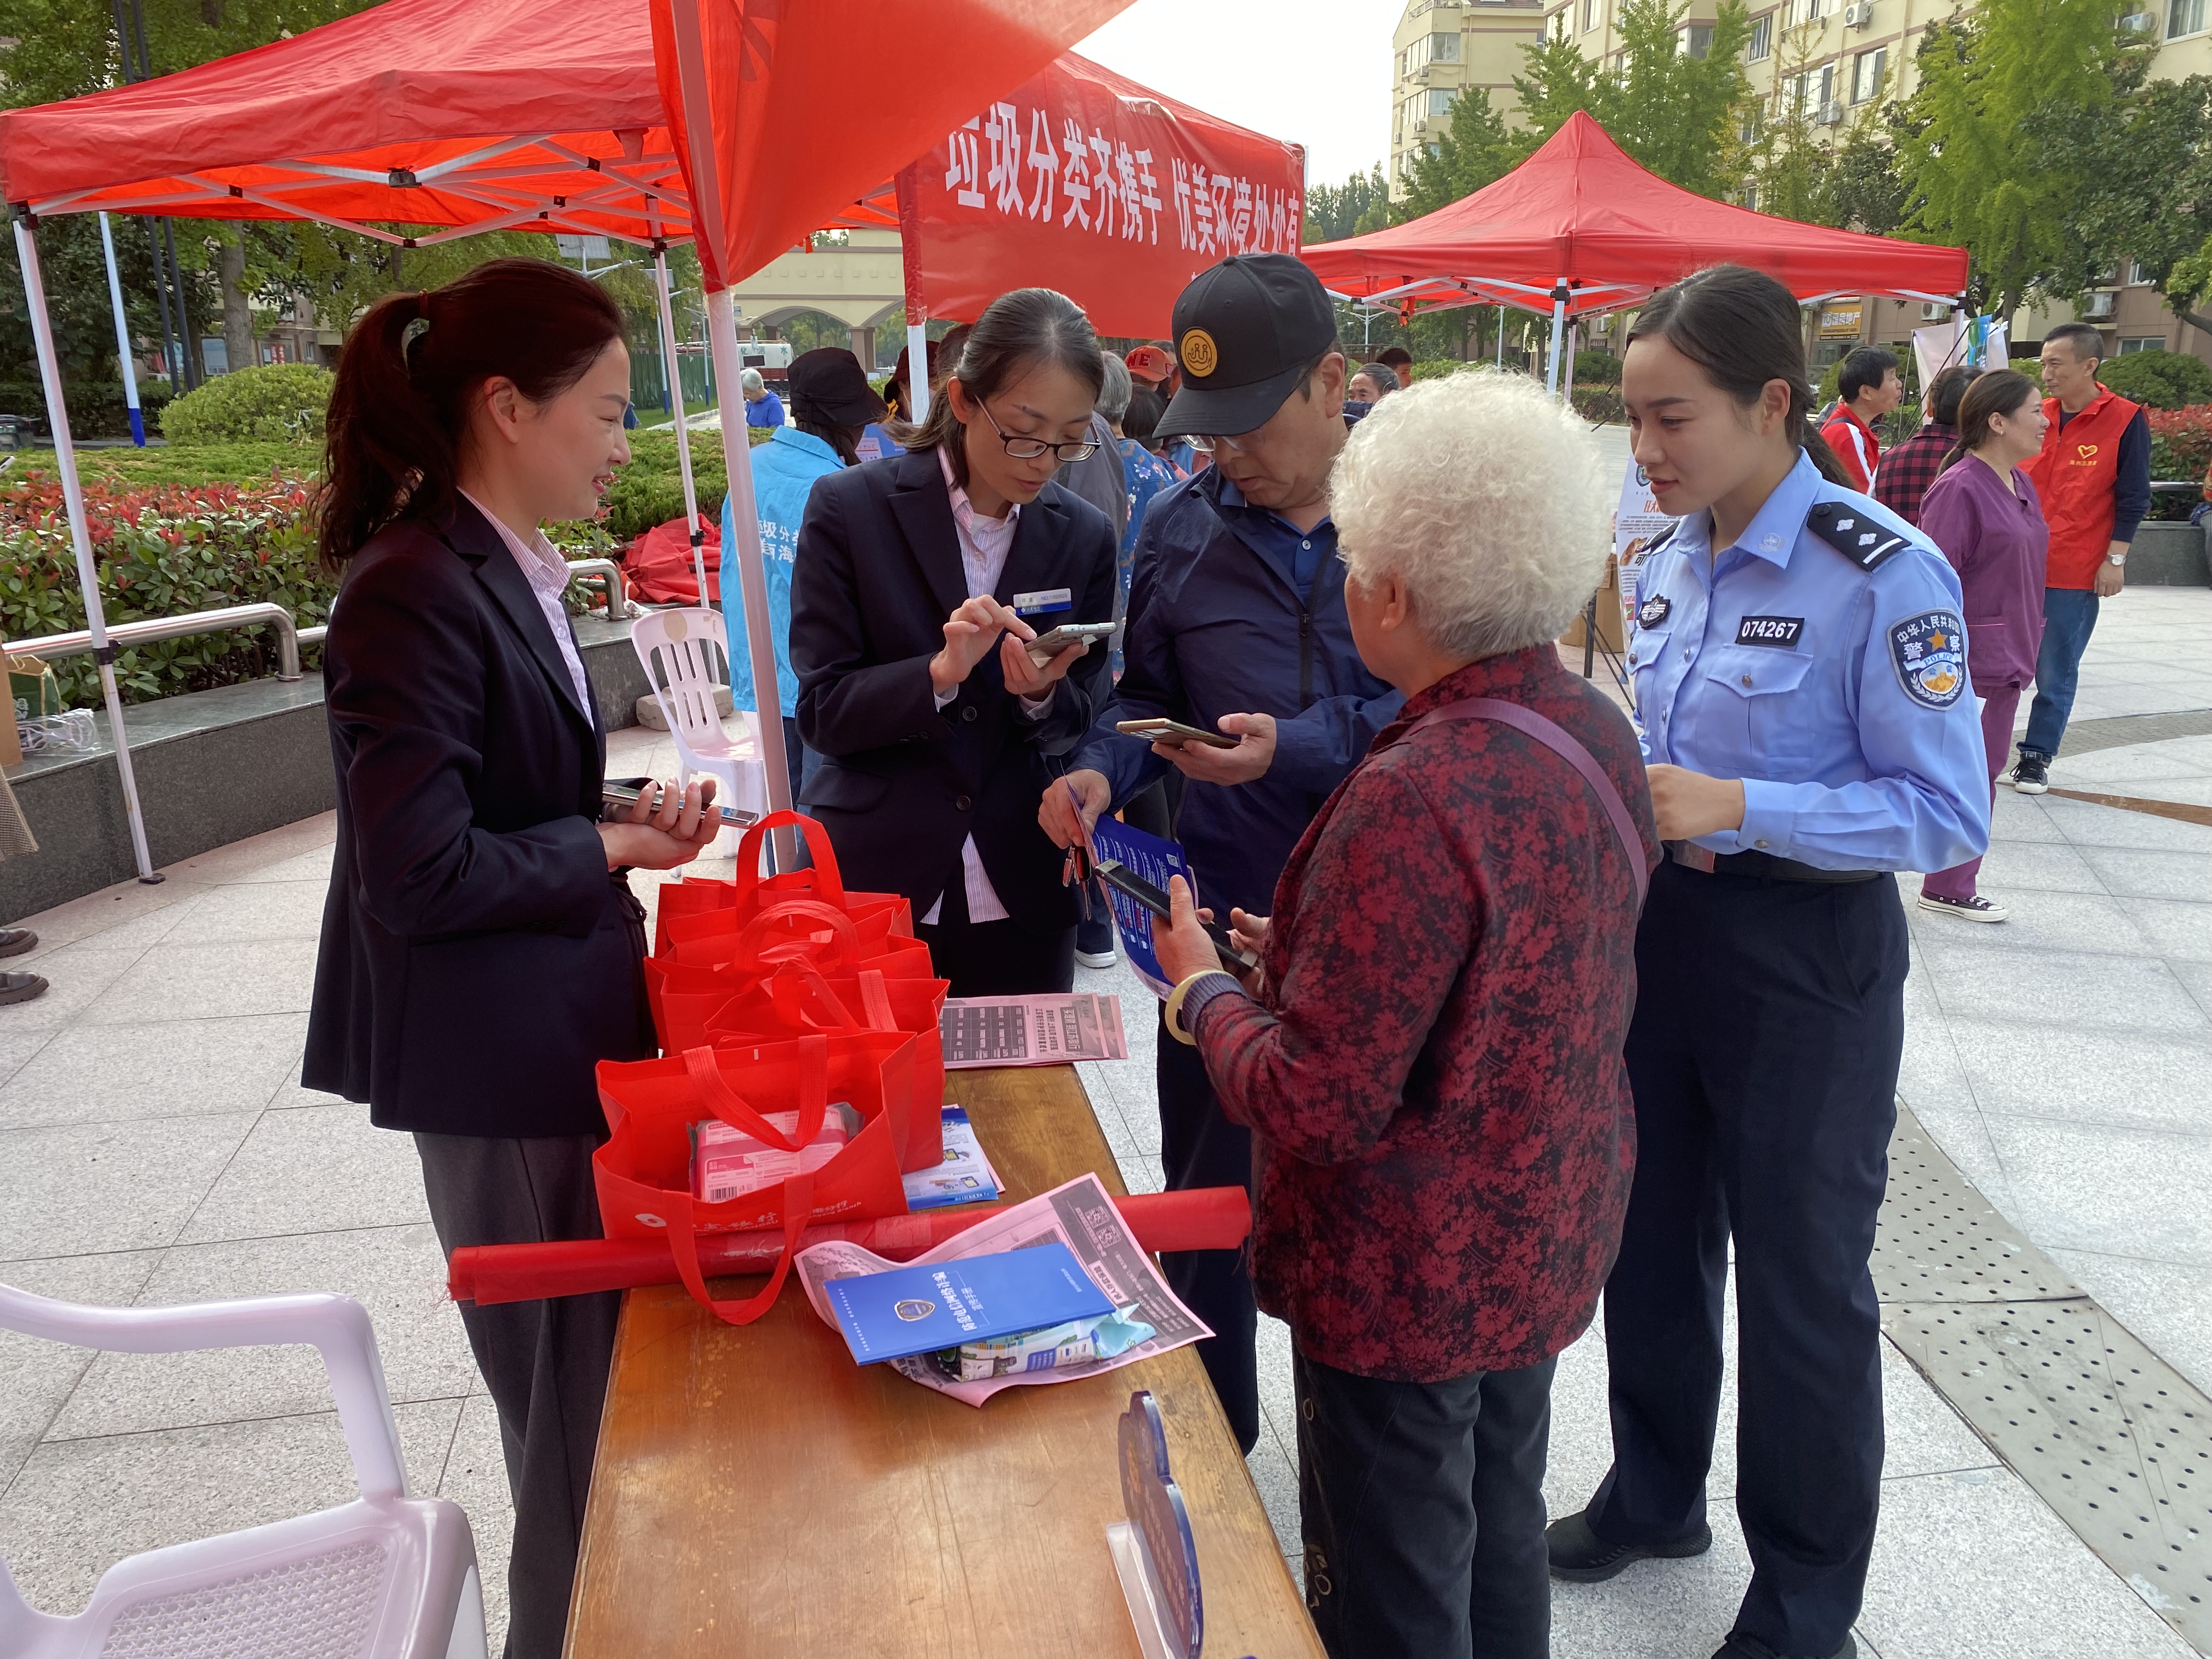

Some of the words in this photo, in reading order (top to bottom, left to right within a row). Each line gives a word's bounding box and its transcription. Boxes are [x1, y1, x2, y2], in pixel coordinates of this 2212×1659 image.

[945, 101, 1162, 246] 垃圾分类齐携手
[1741, 620, 1798, 640] 074267
[1896, 614, 1960, 644] 中华人民共和国
[1903, 641, 1923, 660] 警
[1949, 634, 1960, 652] 察
[1923, 653, 1953, 667] POLICE
[810, 1199, 848, 1215] 港分行
